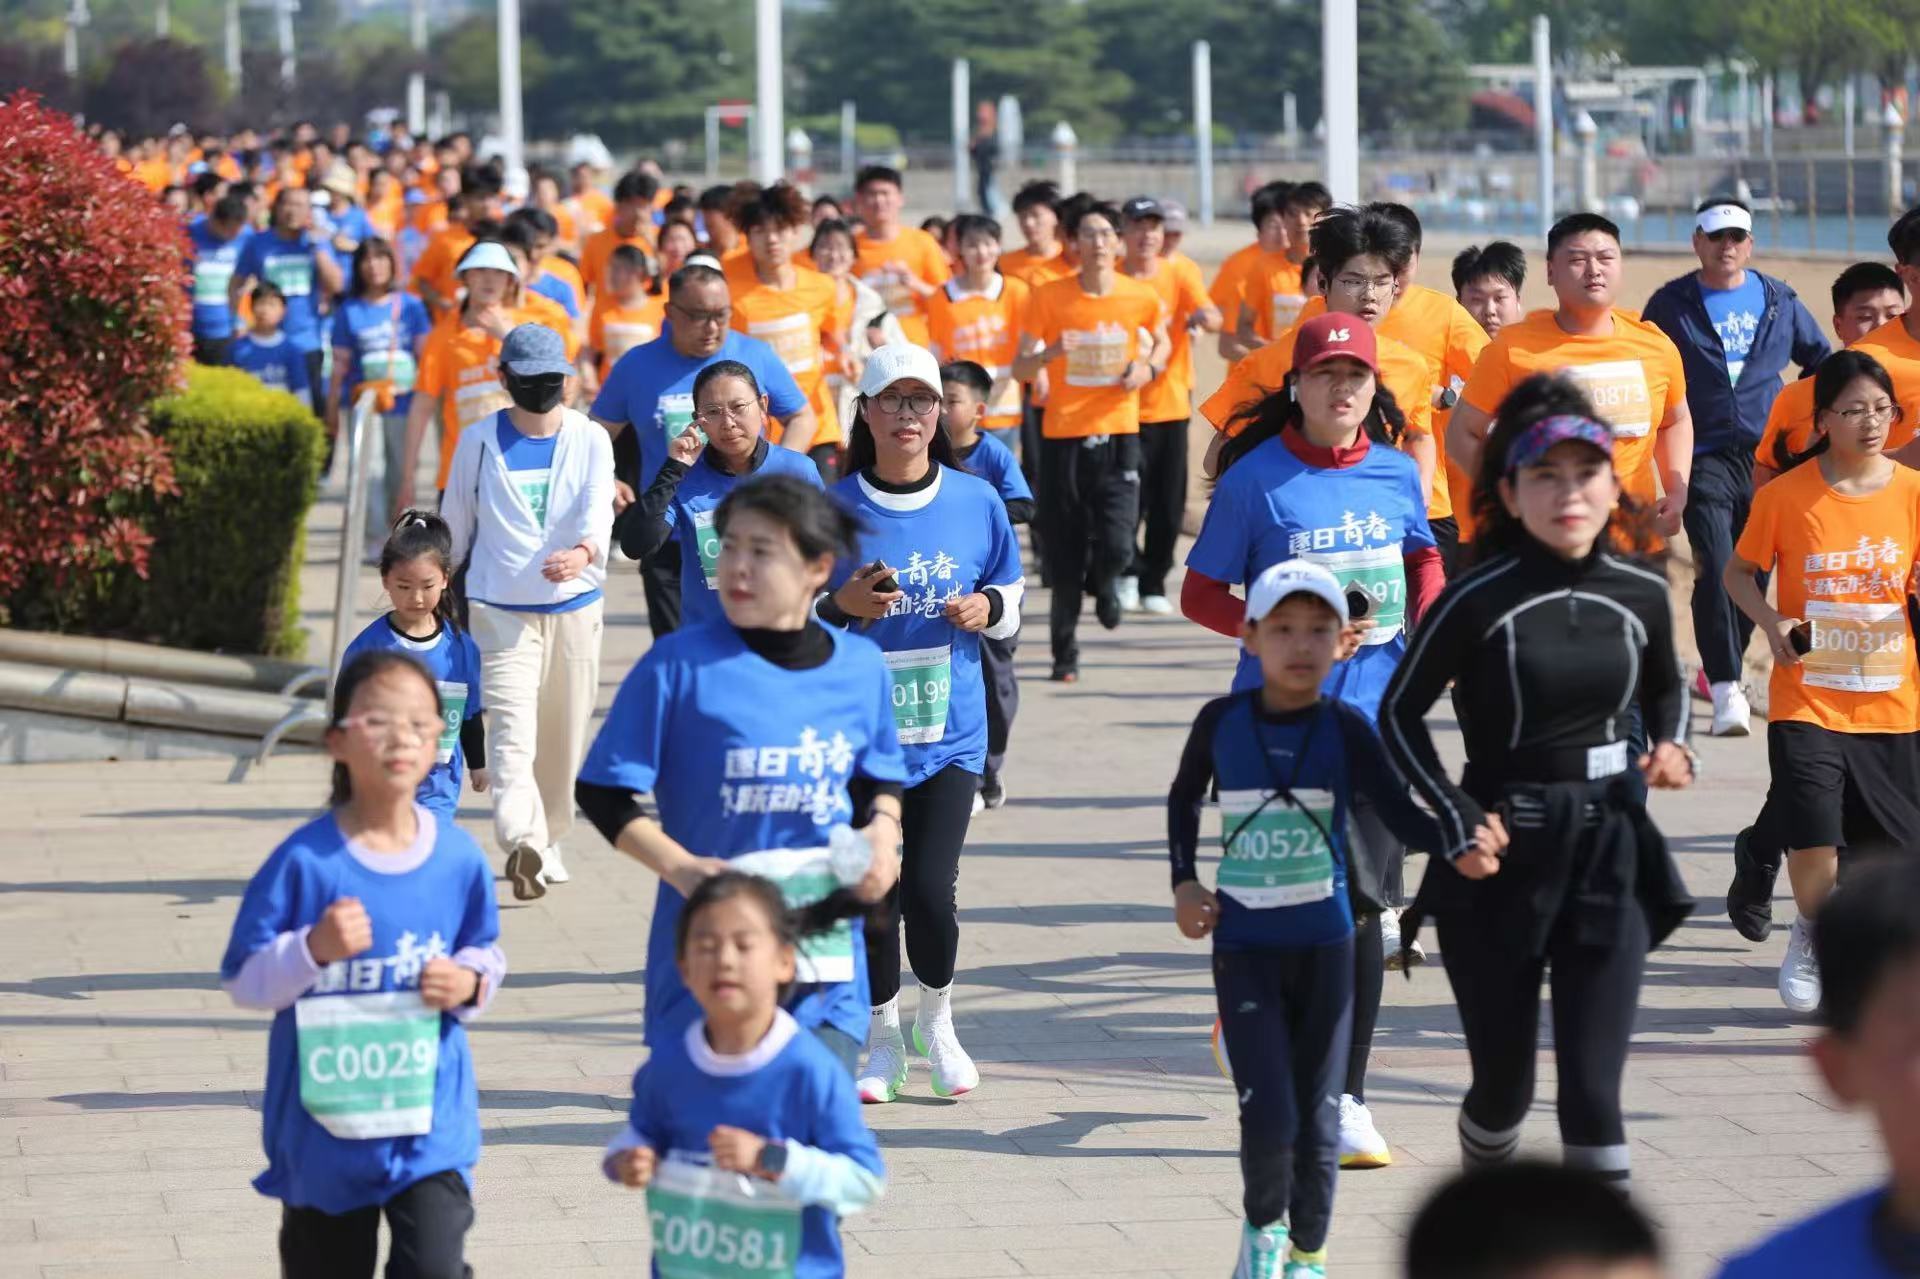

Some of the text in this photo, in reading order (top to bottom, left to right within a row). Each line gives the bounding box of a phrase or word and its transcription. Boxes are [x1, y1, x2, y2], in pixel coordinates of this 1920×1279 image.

[1288, 509, 1393, 555] 逐日青春
[1805, 535, 1904, 573] 逐日青春
